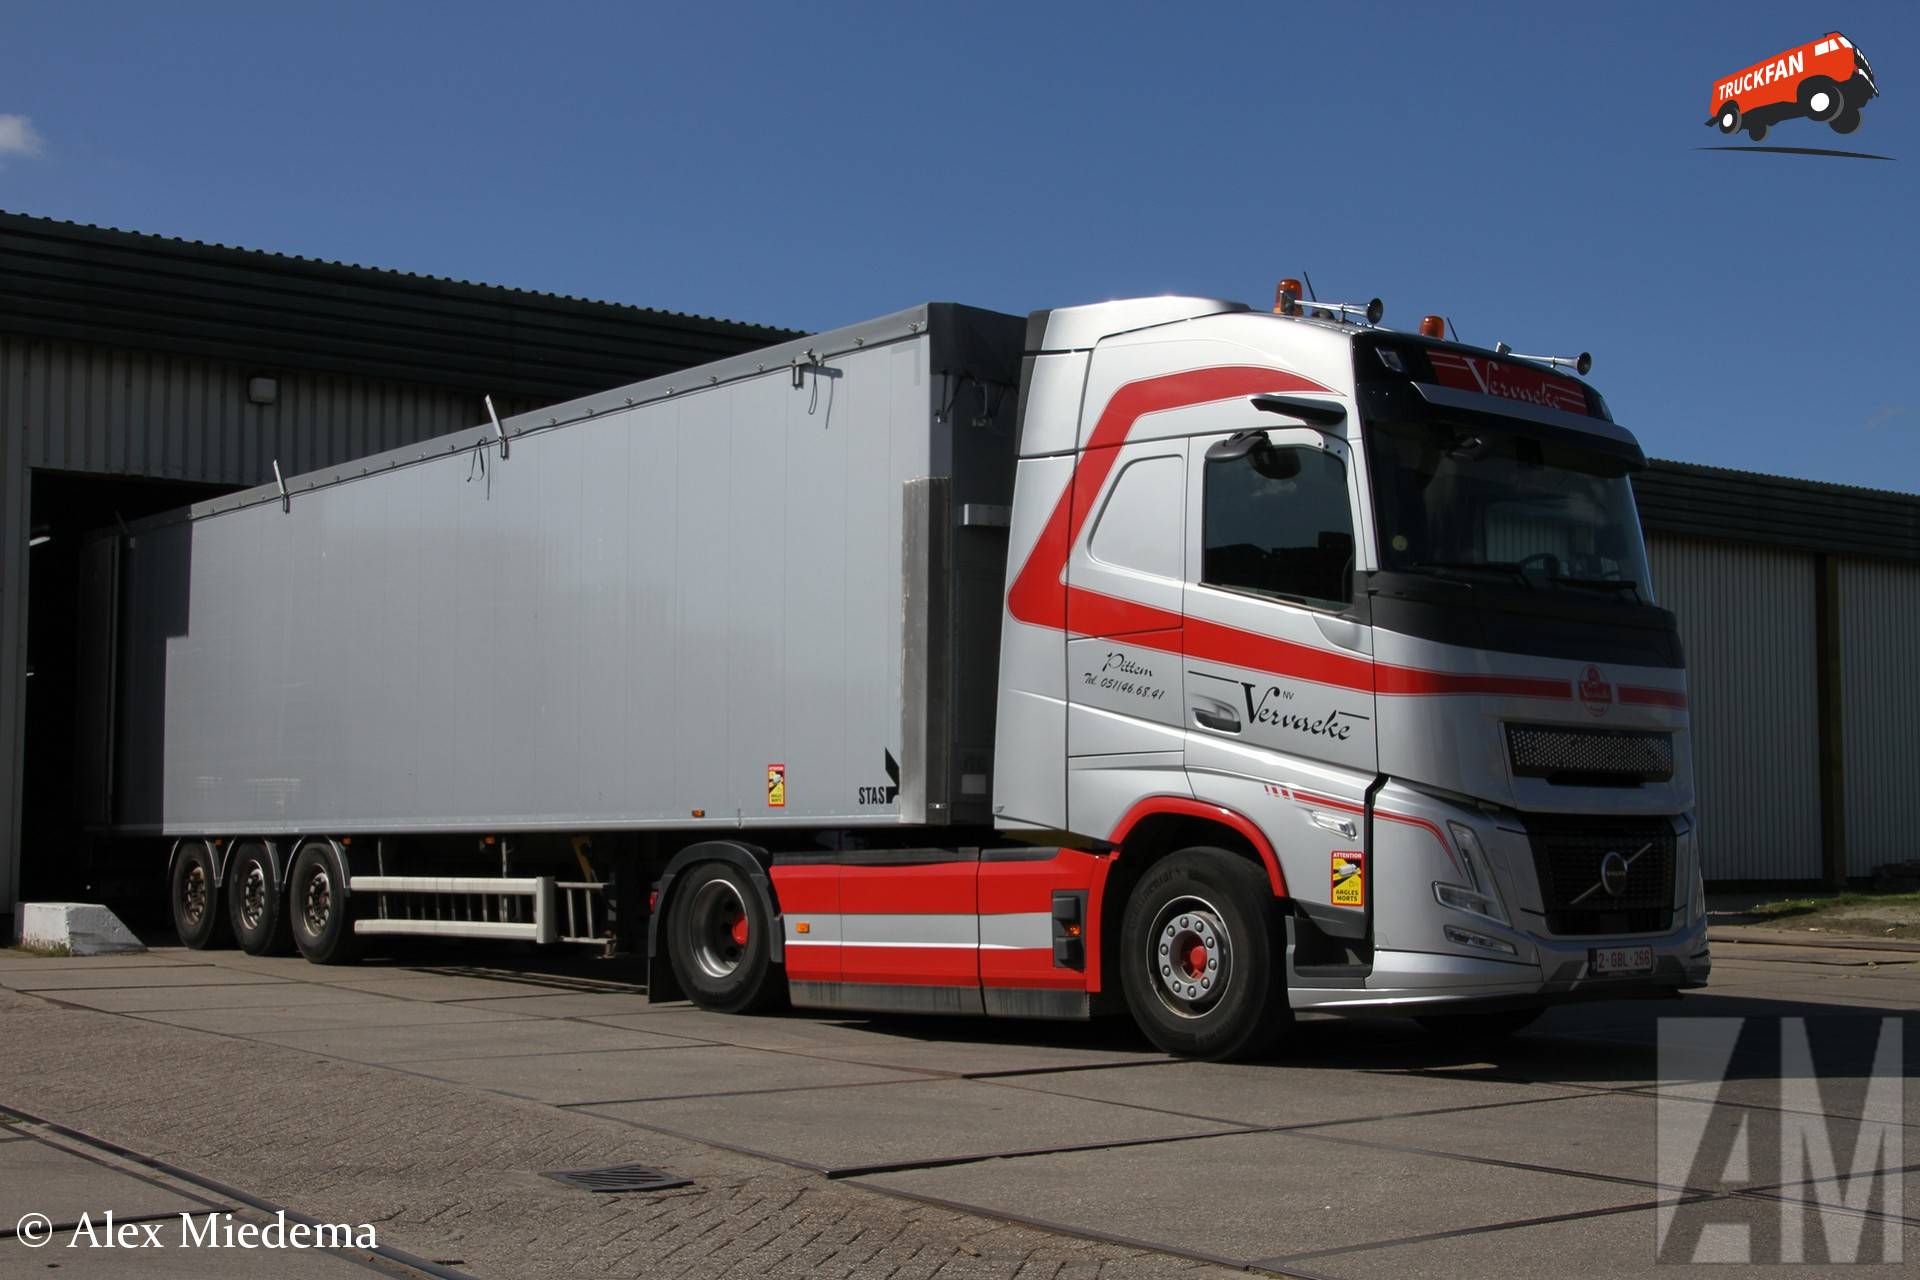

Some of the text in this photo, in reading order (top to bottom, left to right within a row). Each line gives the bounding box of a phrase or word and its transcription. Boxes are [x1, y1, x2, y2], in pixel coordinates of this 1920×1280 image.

[1462, 356, 1561, 409] Vervaeke
[1101, 652, 1153, 678] Pittem
[1282, 690, 1295, 699] NV
[1240, 682, 1352, 740] Vervaeke
[858, 786, 885, 805] STAS
